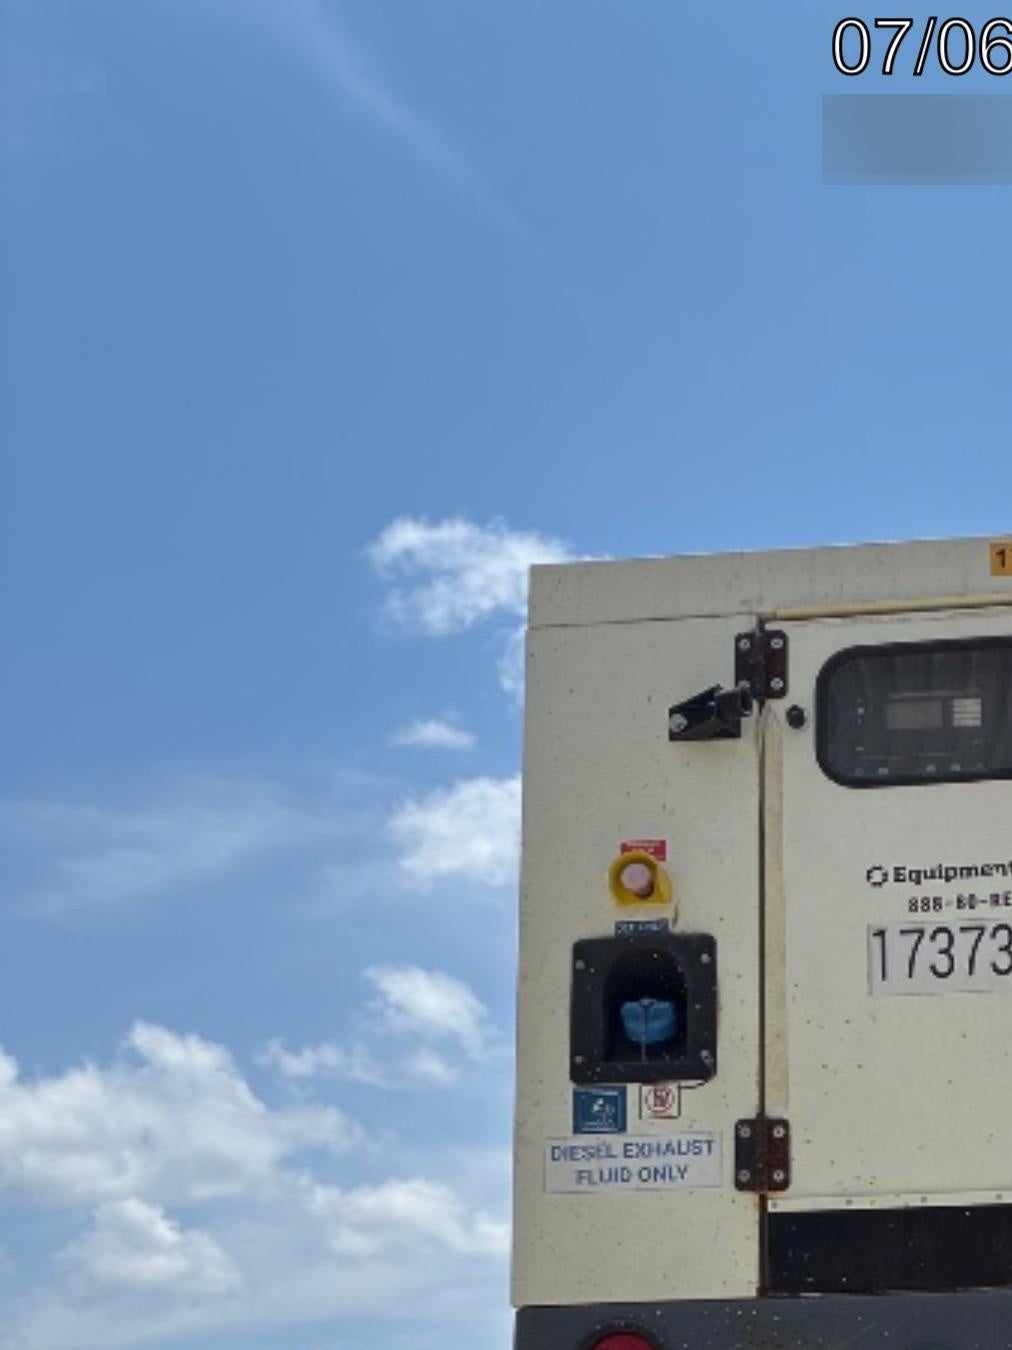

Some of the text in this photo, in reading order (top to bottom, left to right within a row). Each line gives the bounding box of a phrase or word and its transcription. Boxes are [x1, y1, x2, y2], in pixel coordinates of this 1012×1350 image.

[551, 1138, 716, 1162] DIESEL EXHAUST
[575, 1163, 689, 1186] FLUID ONLY
